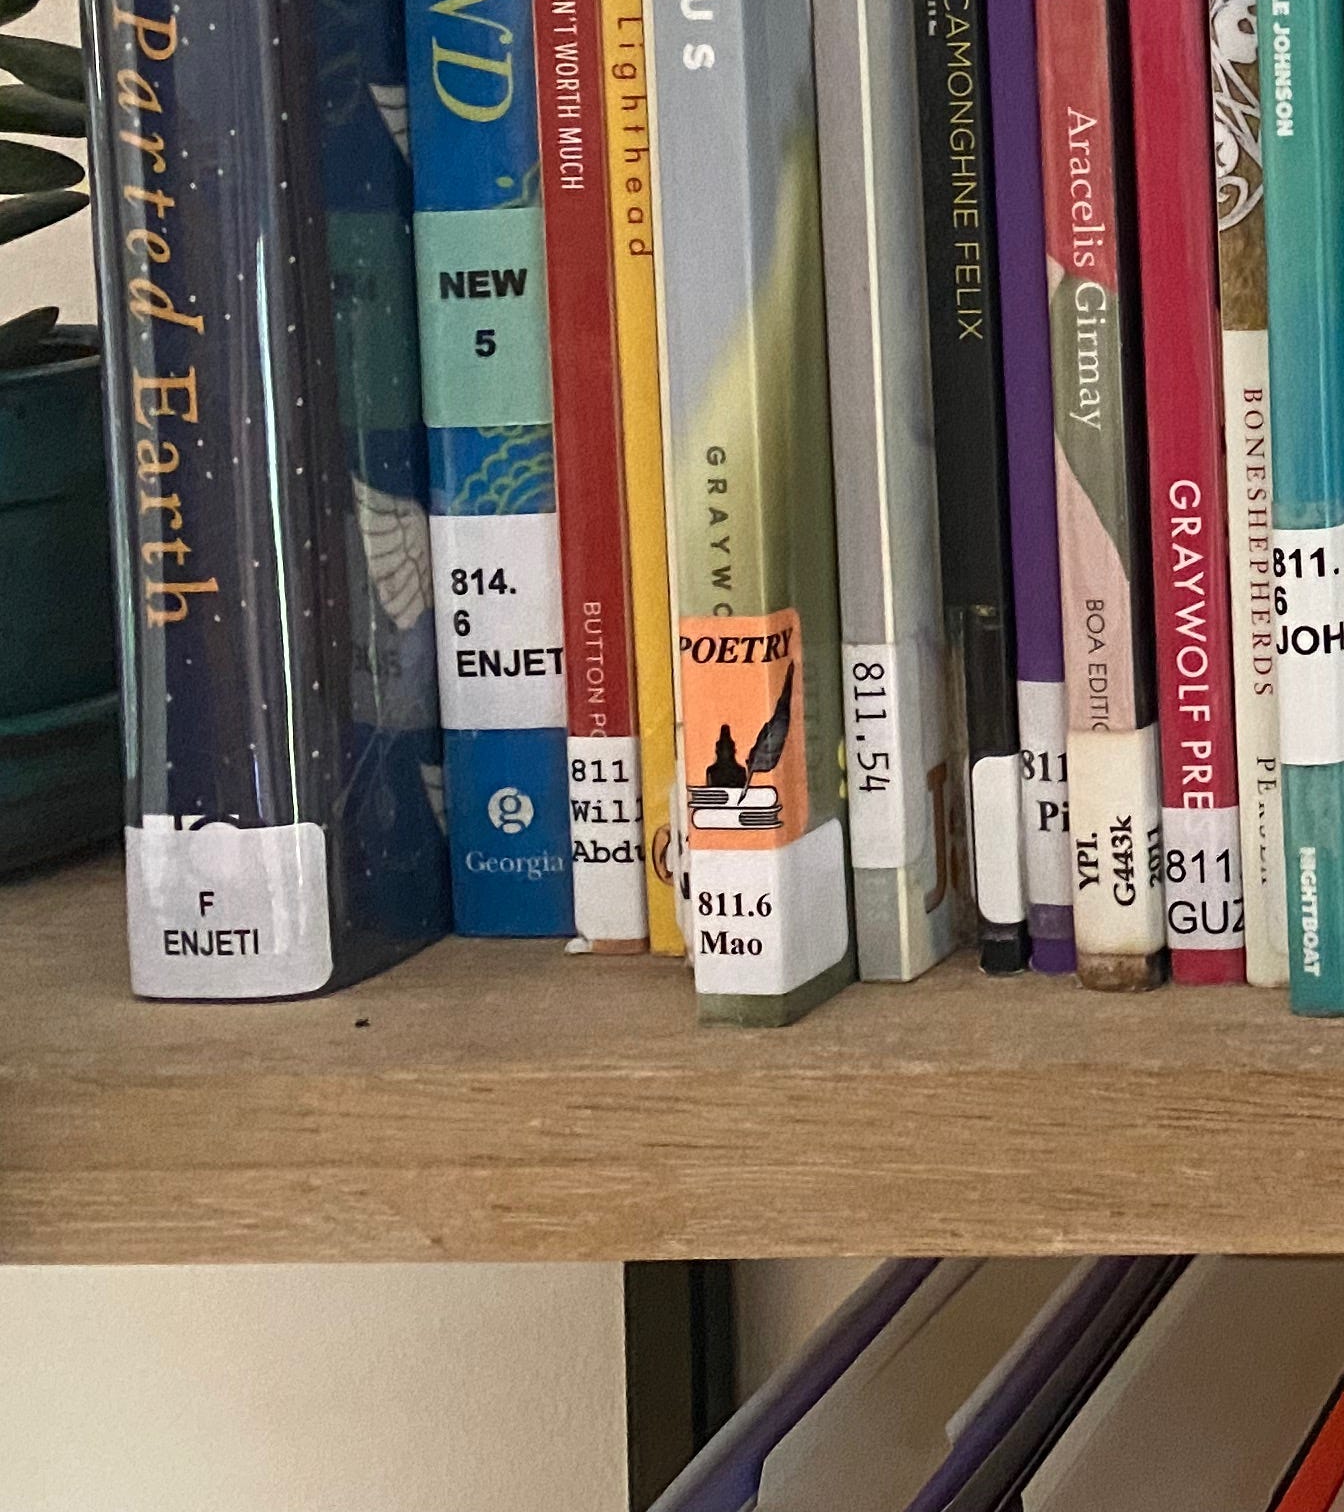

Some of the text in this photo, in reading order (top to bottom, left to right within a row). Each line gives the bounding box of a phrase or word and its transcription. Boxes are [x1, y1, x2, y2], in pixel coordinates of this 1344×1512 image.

[553, 41, 582, 119] WORTH
[612, 15, 654, 258] Lighthead
[112, 6, 205, 336] Parted
[558, 126, 585, 192] MUCH
[1066, 105, 1109, 431] Aracelis Girmay
[440, 268, 528, 299] NEW
[475, 330, 497, 358] 5
[132, 365, 220, 629] Earth
[451, 569, 517, 596] 814.
[1273, 586, 1289, 616] 6
[453, 610, 471, 637] 6
[571, 758, 630, 784] 811
[199, 891, 215, 917] F
[698, 891, 773, 919] 811.6
[1298, 845, 1322, 978] NIGHTBOAT
[164, 929, 261, 957] ENJETI
[699, 931, 764, 957] Mao
